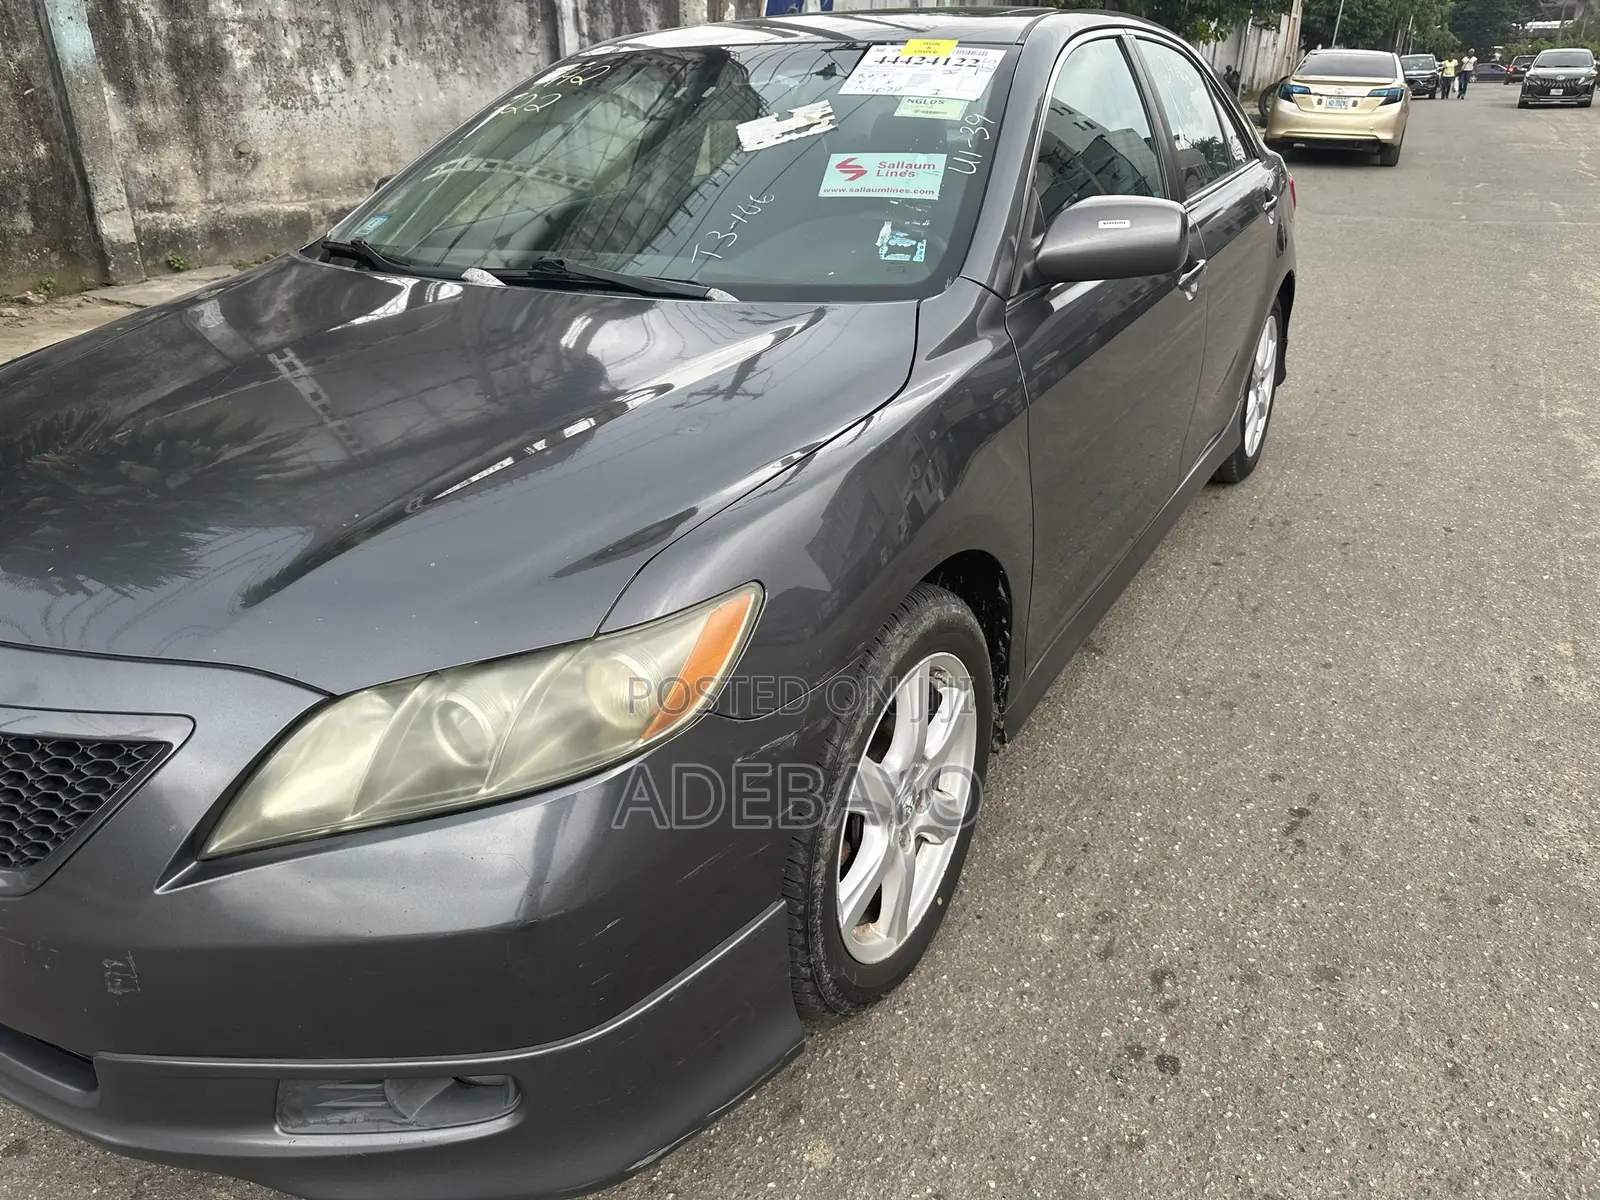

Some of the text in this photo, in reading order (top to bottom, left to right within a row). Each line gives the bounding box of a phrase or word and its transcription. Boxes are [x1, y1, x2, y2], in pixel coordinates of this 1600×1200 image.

[874, 55, 980, 68] 44424122
[878, 161, 936, 170] Sallaum
[876, 170, 916, 178] Lines
[823, 186, 935, 195] www.sallaumlines.com
